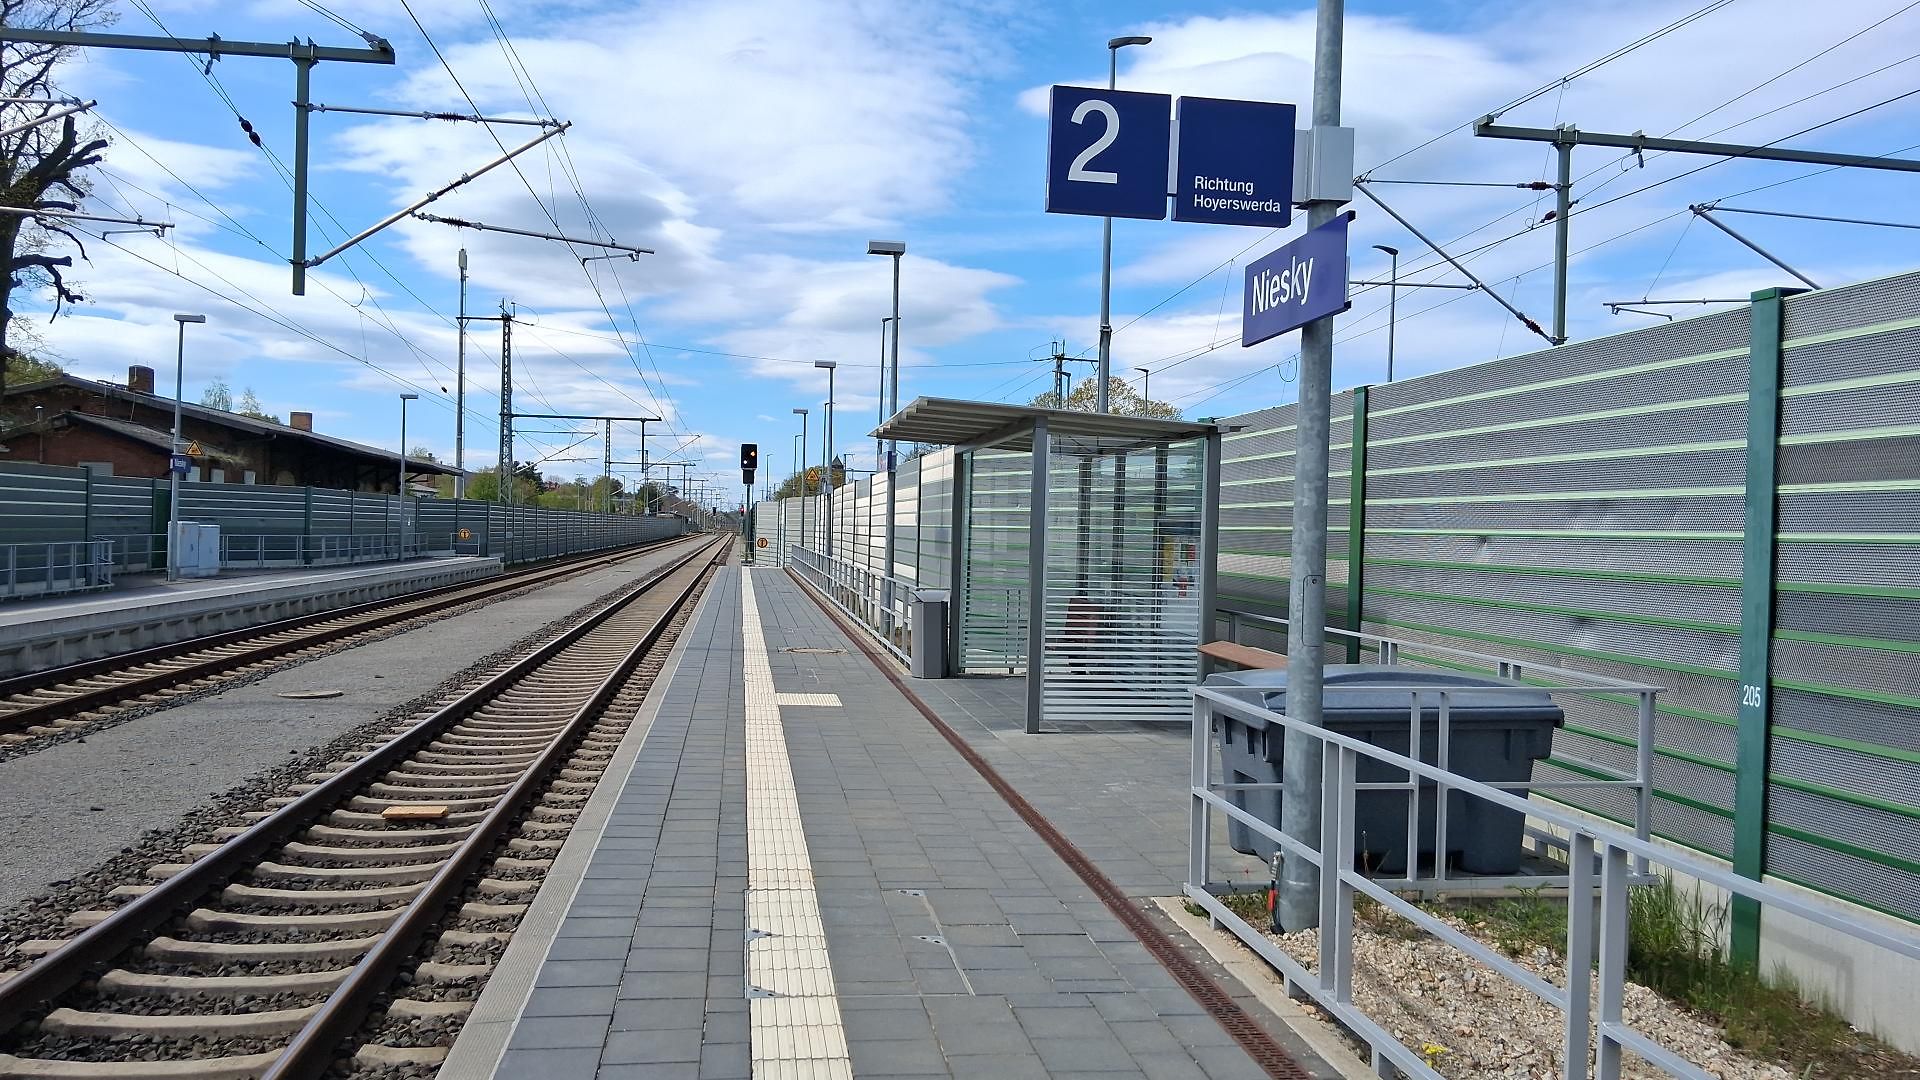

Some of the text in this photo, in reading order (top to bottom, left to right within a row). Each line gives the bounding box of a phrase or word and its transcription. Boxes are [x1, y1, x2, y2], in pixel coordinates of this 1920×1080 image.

[1067, 99, 1120, 184] 2
[1194, 175, 1254, 195] Richtung
[1193, 194, 1281, 213] Hoyerswerda
[1252, 255, 1314, 316] Niesky
[1742, 684, 1761, 707] 205
